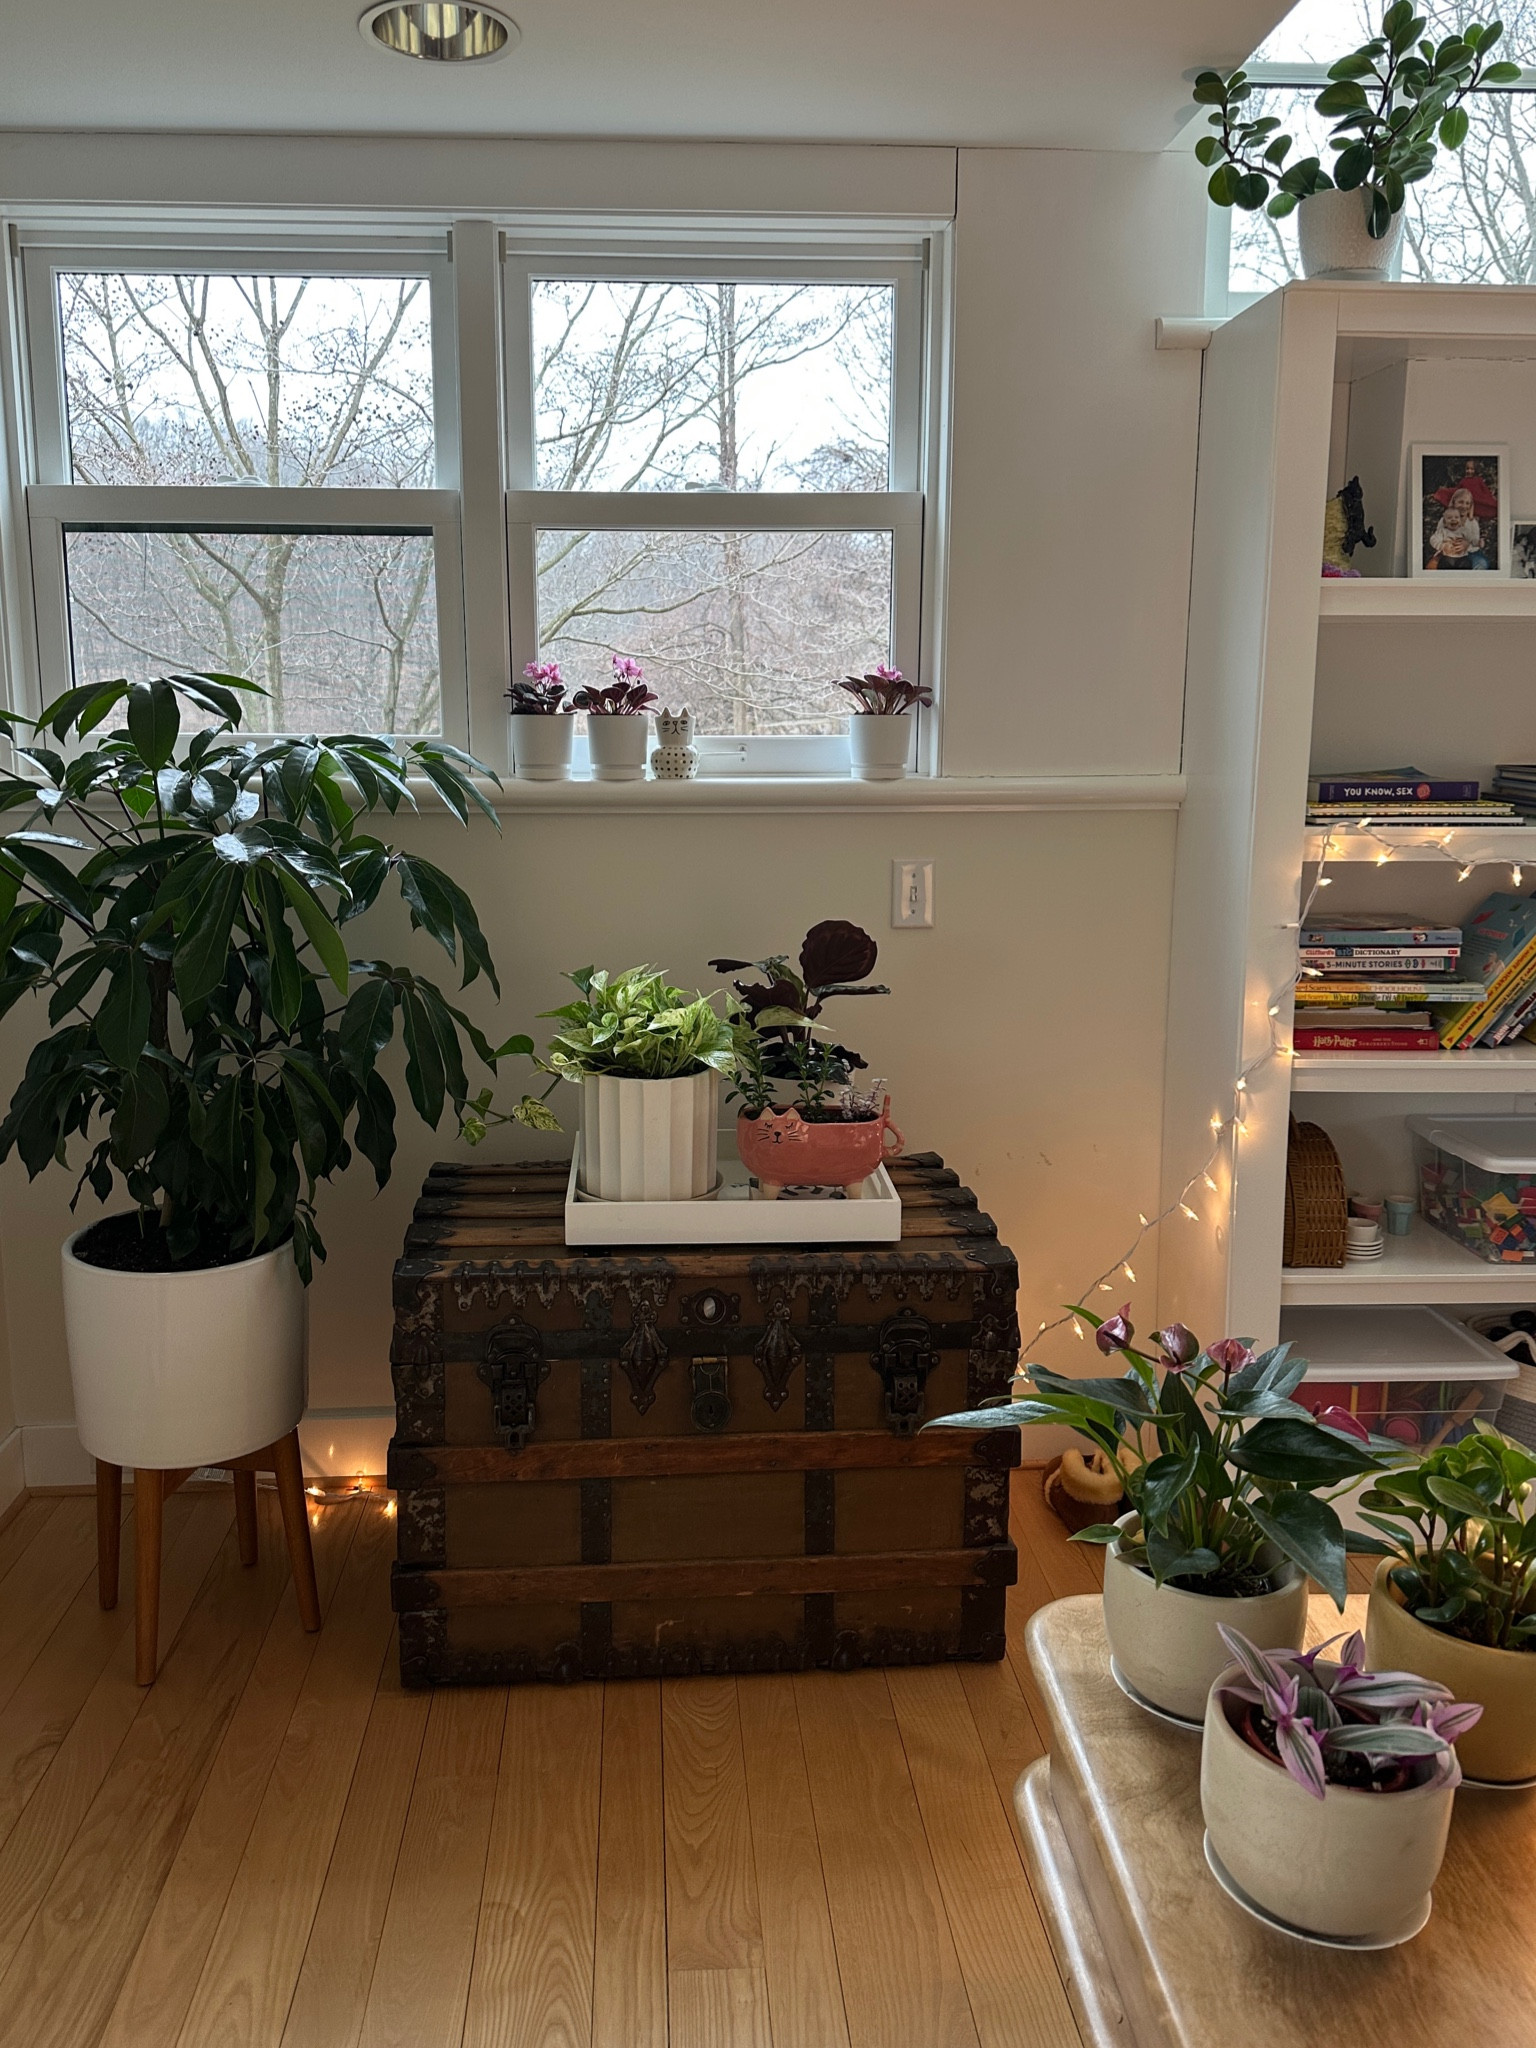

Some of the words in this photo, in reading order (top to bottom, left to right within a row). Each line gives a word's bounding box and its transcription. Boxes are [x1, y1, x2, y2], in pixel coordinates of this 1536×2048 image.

[1344, 787, 1362, 796] YOU
[1364, 787, 1395, 796] KNOW,
[1396, 787, 1414, 796] SEX
[1326, 961, 1367, 969] 5-MINUTE
[1312, 1035, 1334, 1047] Harry
[1334, 1035, 1357, 1047] Potter
